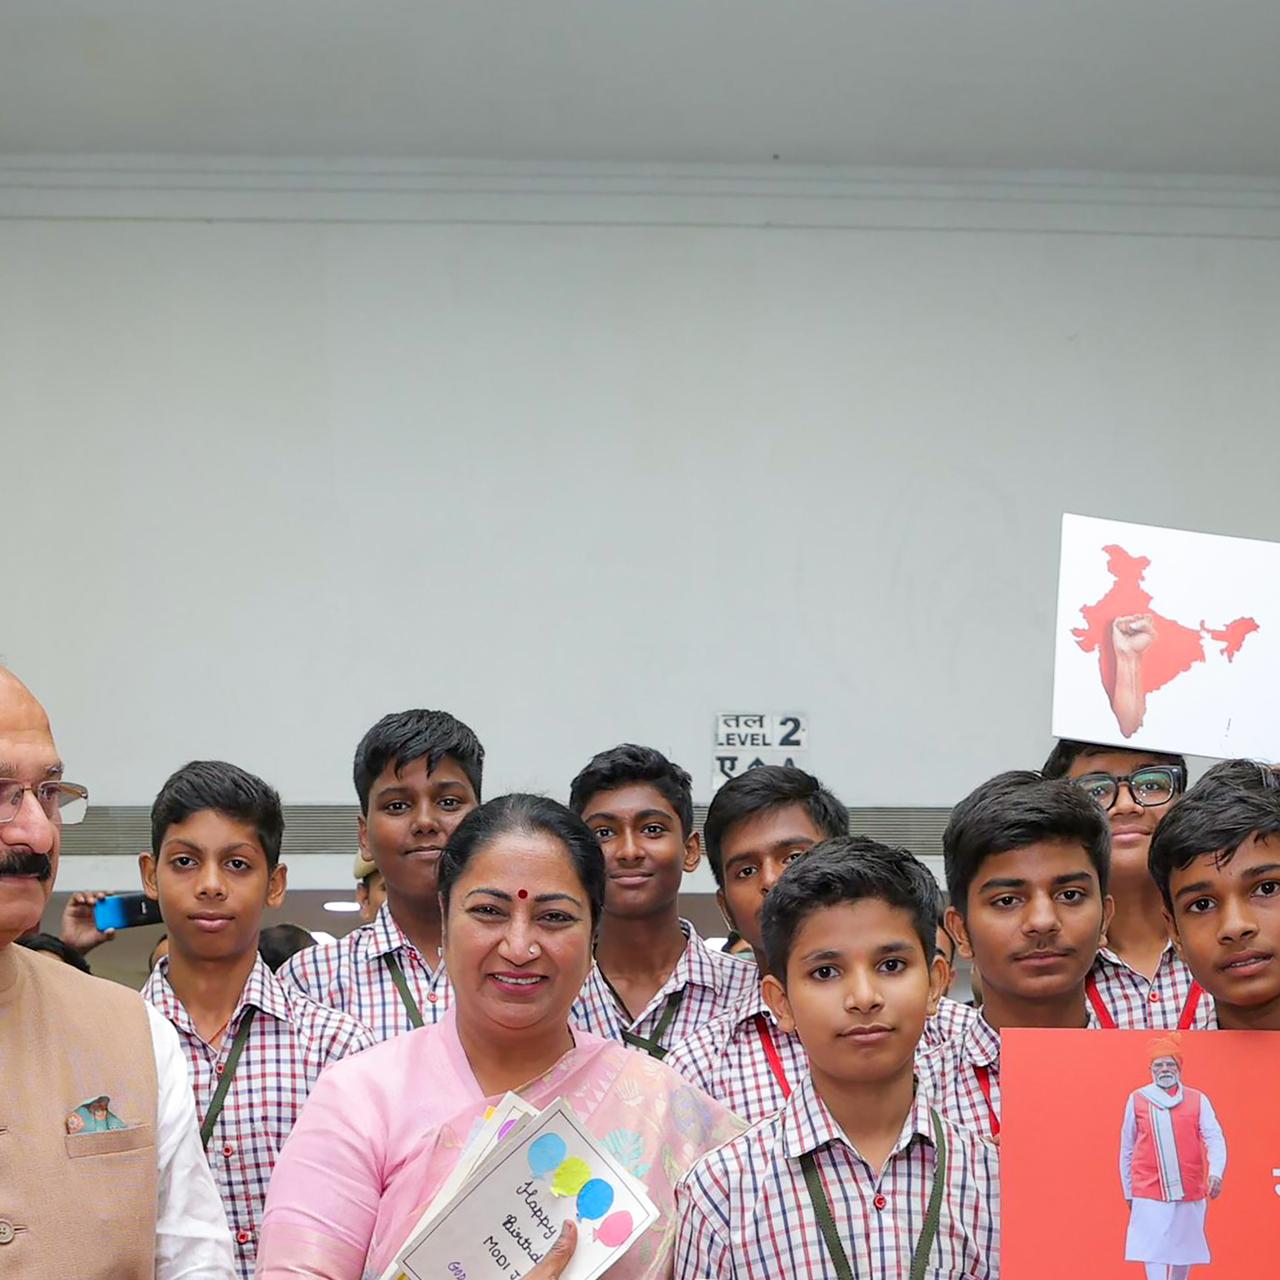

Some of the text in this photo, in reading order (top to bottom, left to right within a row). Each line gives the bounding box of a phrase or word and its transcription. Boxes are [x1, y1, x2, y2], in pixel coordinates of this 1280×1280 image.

[721, 713, 766, 728] तल
[778, 716, 801, 747] 2
[516, 1181, 557, 1240] Happy
[483, 1235, 511, 1271] MODI
[447, 1261, 467, 1280] GOD
